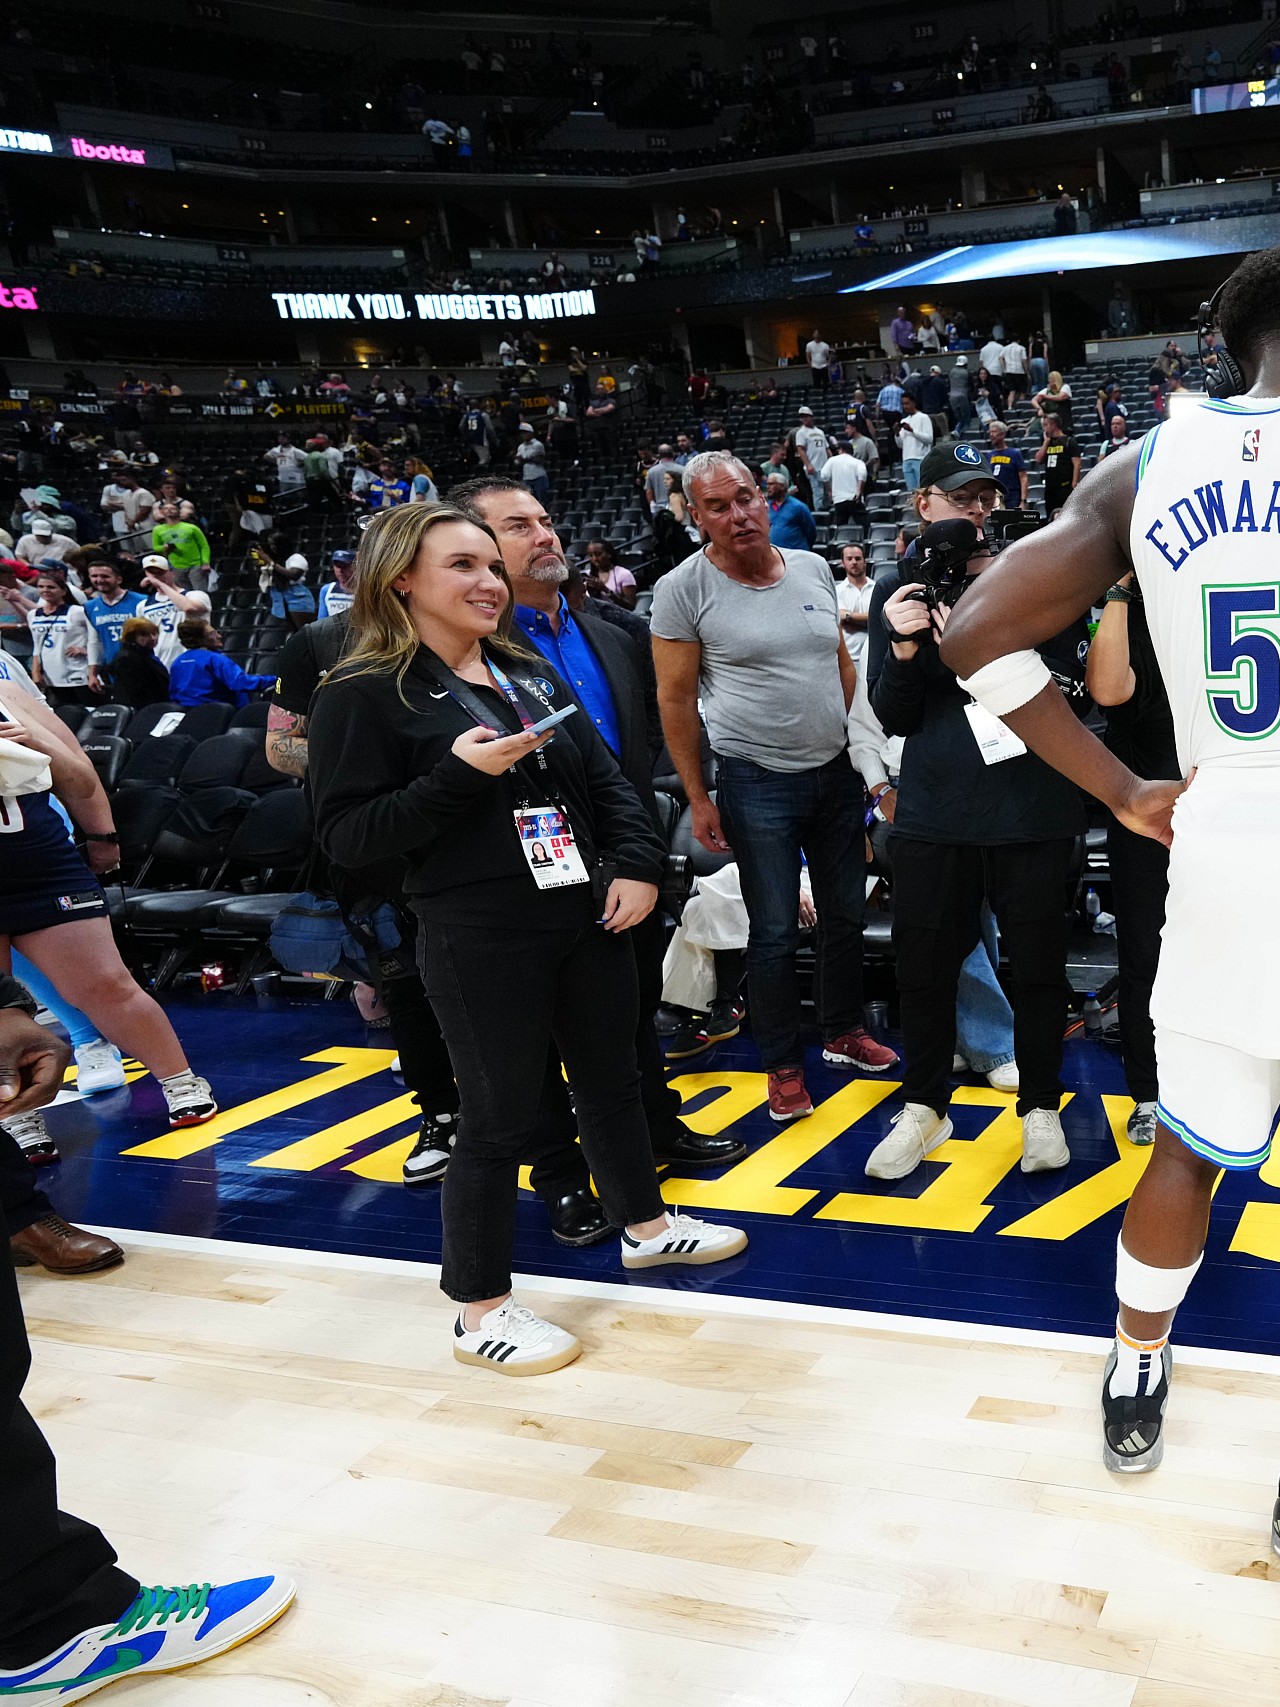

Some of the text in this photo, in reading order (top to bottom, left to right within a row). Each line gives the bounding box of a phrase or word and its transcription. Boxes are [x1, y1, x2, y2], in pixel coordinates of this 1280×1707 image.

[0, 128, 54, 153] ATION
[71, 137, 146, 165] ibotta
[271, 293, 355, 320] THANK
[415, 294, 524, 321] NUGGETS
[523, 289, 597, 320] NATION
[161, 618, 174, 633] 5
